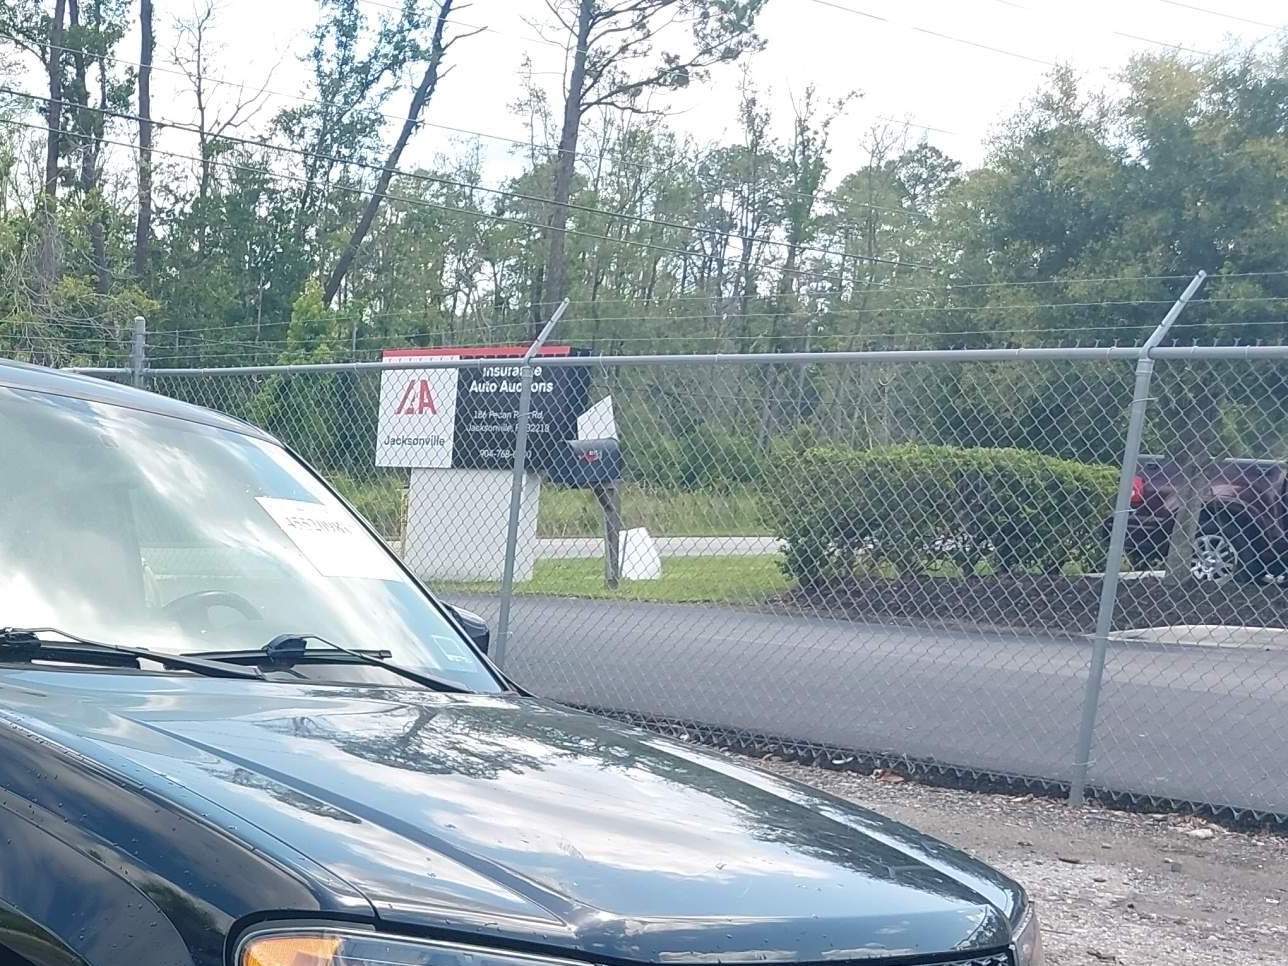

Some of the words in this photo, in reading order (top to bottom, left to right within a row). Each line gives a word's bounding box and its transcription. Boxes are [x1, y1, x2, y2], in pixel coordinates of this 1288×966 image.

[482, 366, 543, 377] Insurae
[469, 379, 497, 393] Auto
[499, 379, 554, 393] Aucons
[384, 434, 445, 446] Jacksonville
